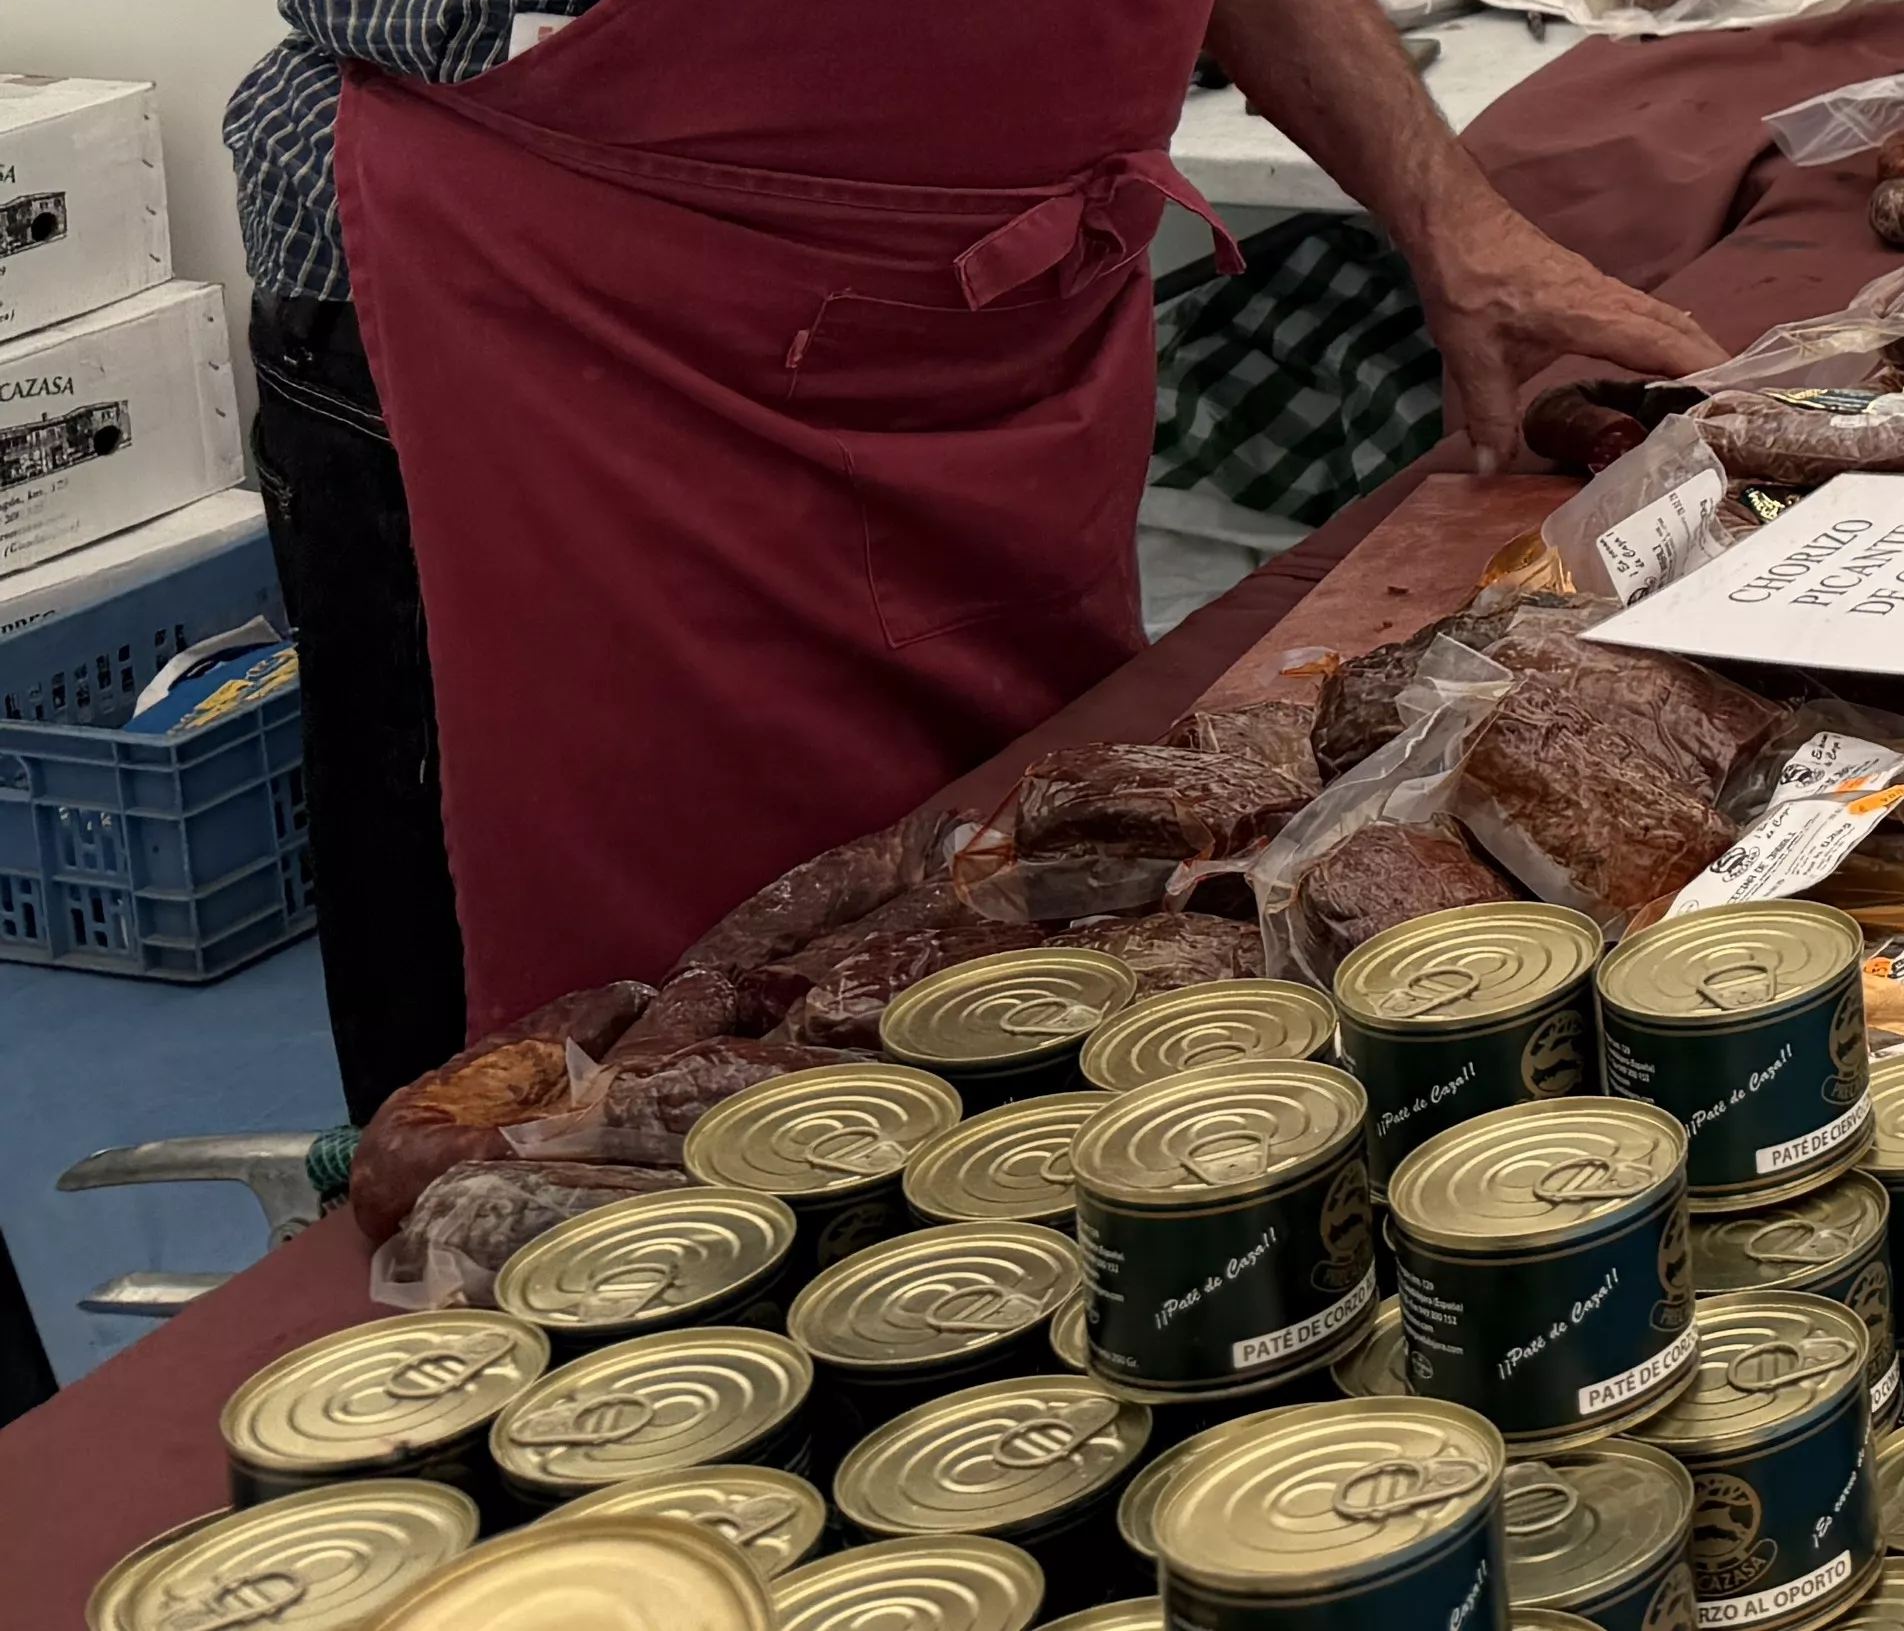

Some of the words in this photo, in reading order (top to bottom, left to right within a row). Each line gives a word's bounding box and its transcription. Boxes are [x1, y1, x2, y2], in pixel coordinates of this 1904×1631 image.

[1729, 519, 1873, 603] CHORIZO
[1730, 1088, 1746, 1105] de
[1772, 1140, 1809, 1166] PATÉ
[1812, 1131, 1829, 1150] DE
[1204, 1276, 1222, 1293] de
[1243, 1329, 1294, 1362] PATÉ
[1298, 1323, 1321, 1344] DE
[1324, 1287, 1366, 1329] CORZO
[1549, 1322, 1568, 1340] de
[1588, 1378, 1636, 1407] PATÉ
[1639, 1363, 1660, 1386] DE
[1700, 1556, 1766, 1590] CAZASA
[1699, 1606, 1738, 1623] RZO
[1744, 1598, 1769, 1617] AL
[1773, 1560, 1847, 1607] OPORTO
